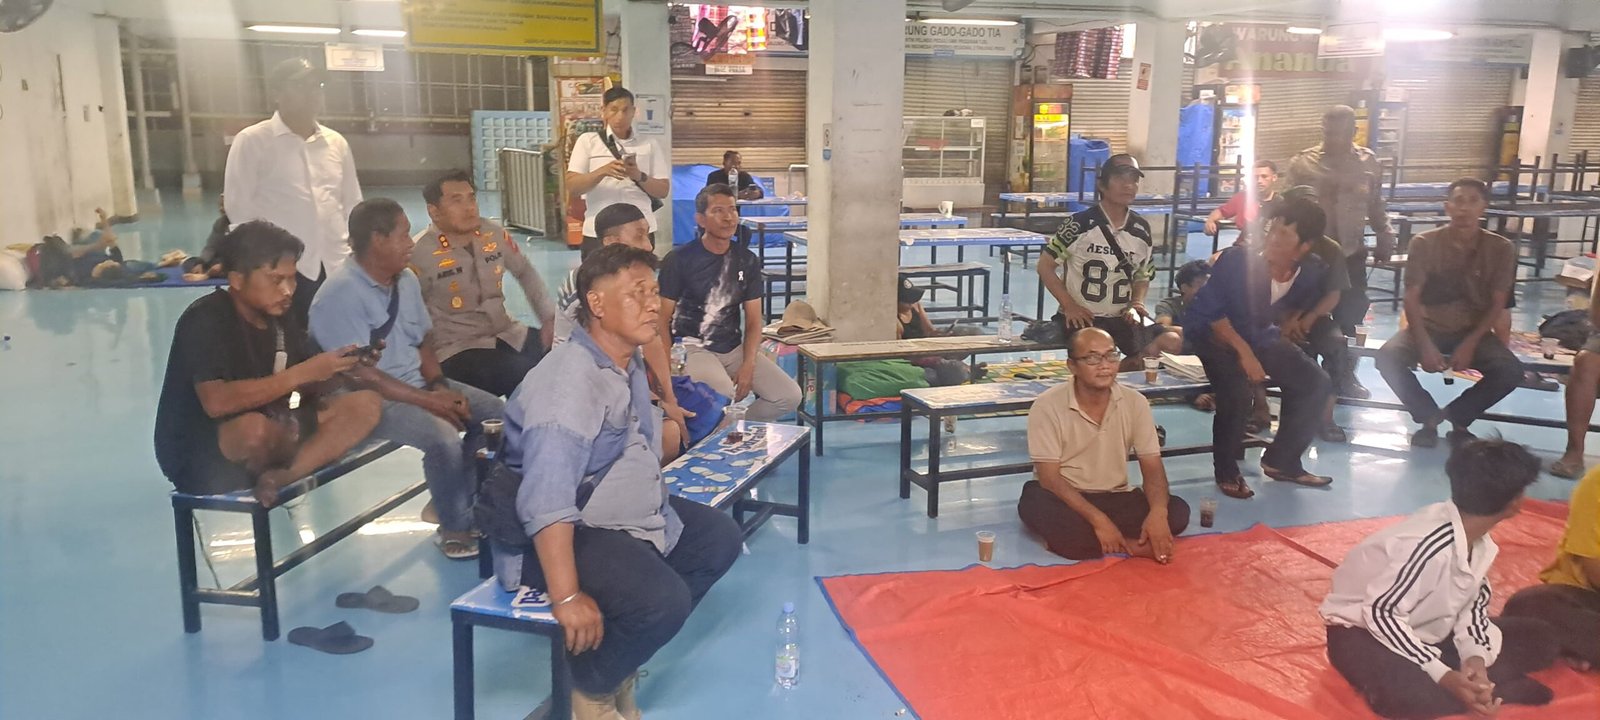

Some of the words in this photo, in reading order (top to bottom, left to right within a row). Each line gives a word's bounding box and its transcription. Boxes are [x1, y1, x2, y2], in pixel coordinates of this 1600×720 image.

[929, 25, 985, 37] GADO-GADO
[987, 27, 1001, 38] TIA
[1081, 259, 1132, 304] 82
